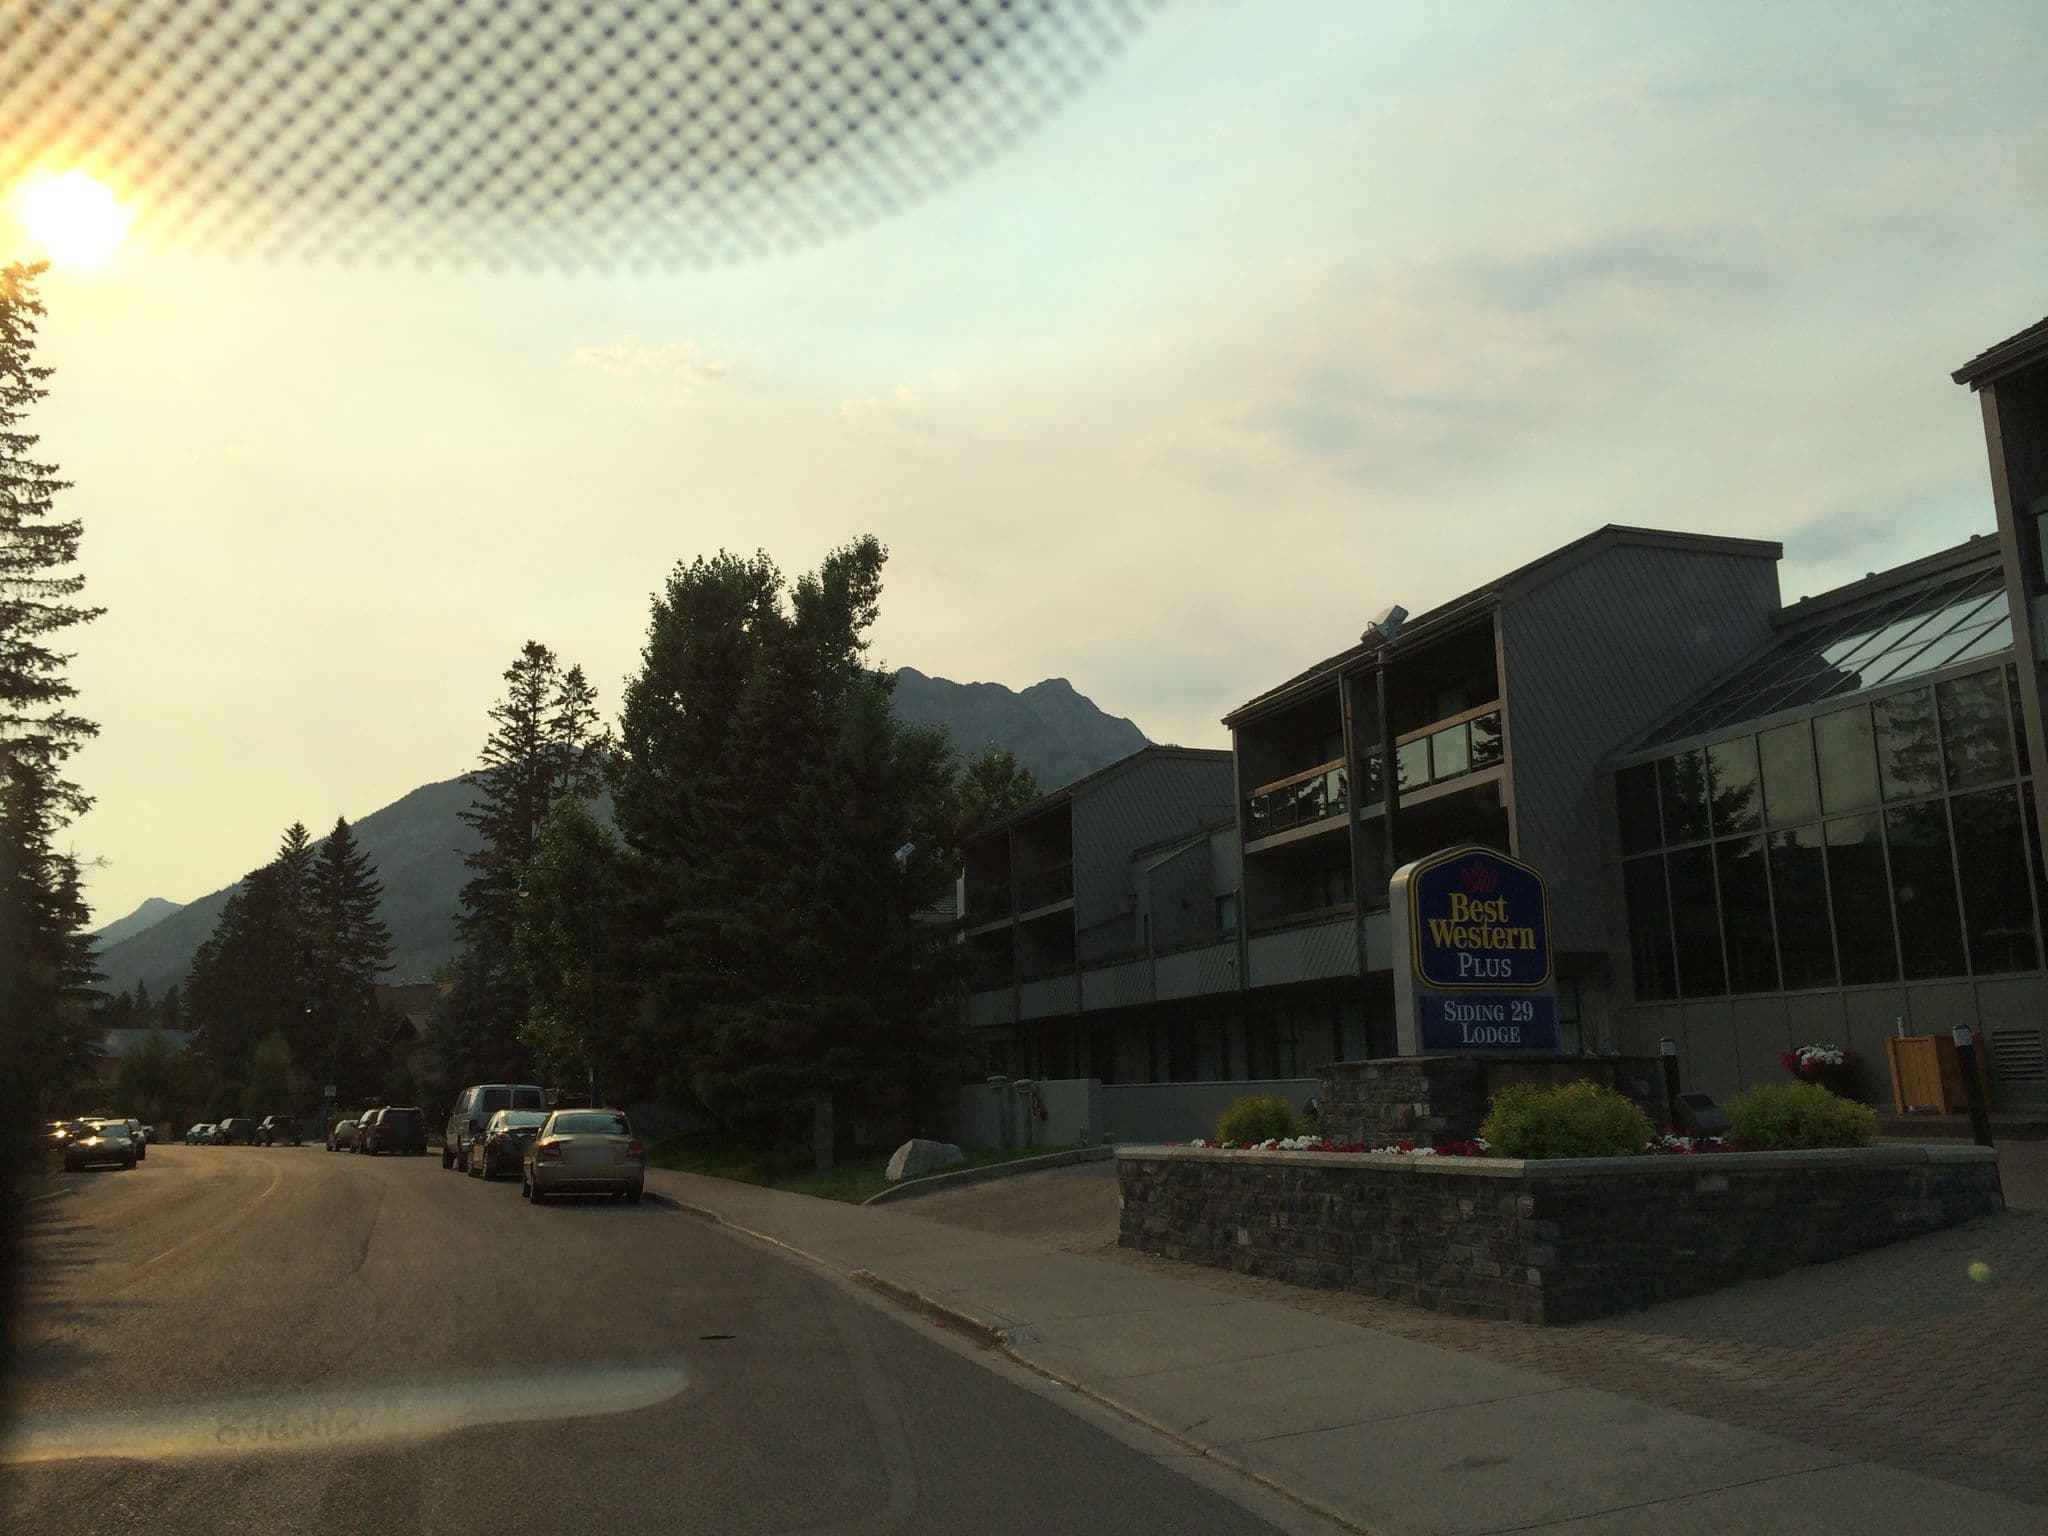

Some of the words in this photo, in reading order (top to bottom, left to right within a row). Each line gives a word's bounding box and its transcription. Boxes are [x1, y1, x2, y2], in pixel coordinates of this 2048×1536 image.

[1449, 893, 1509, 923] Best
[1428, 918, 1536, 950] Western
[1457, 953, 1512, 977] PLUS
[1444, 1000, 1504, 1022] SIDING
[1511, 1001, 1533, 1021] 29
[1461, 1022, 1521, 1043] LODGE
